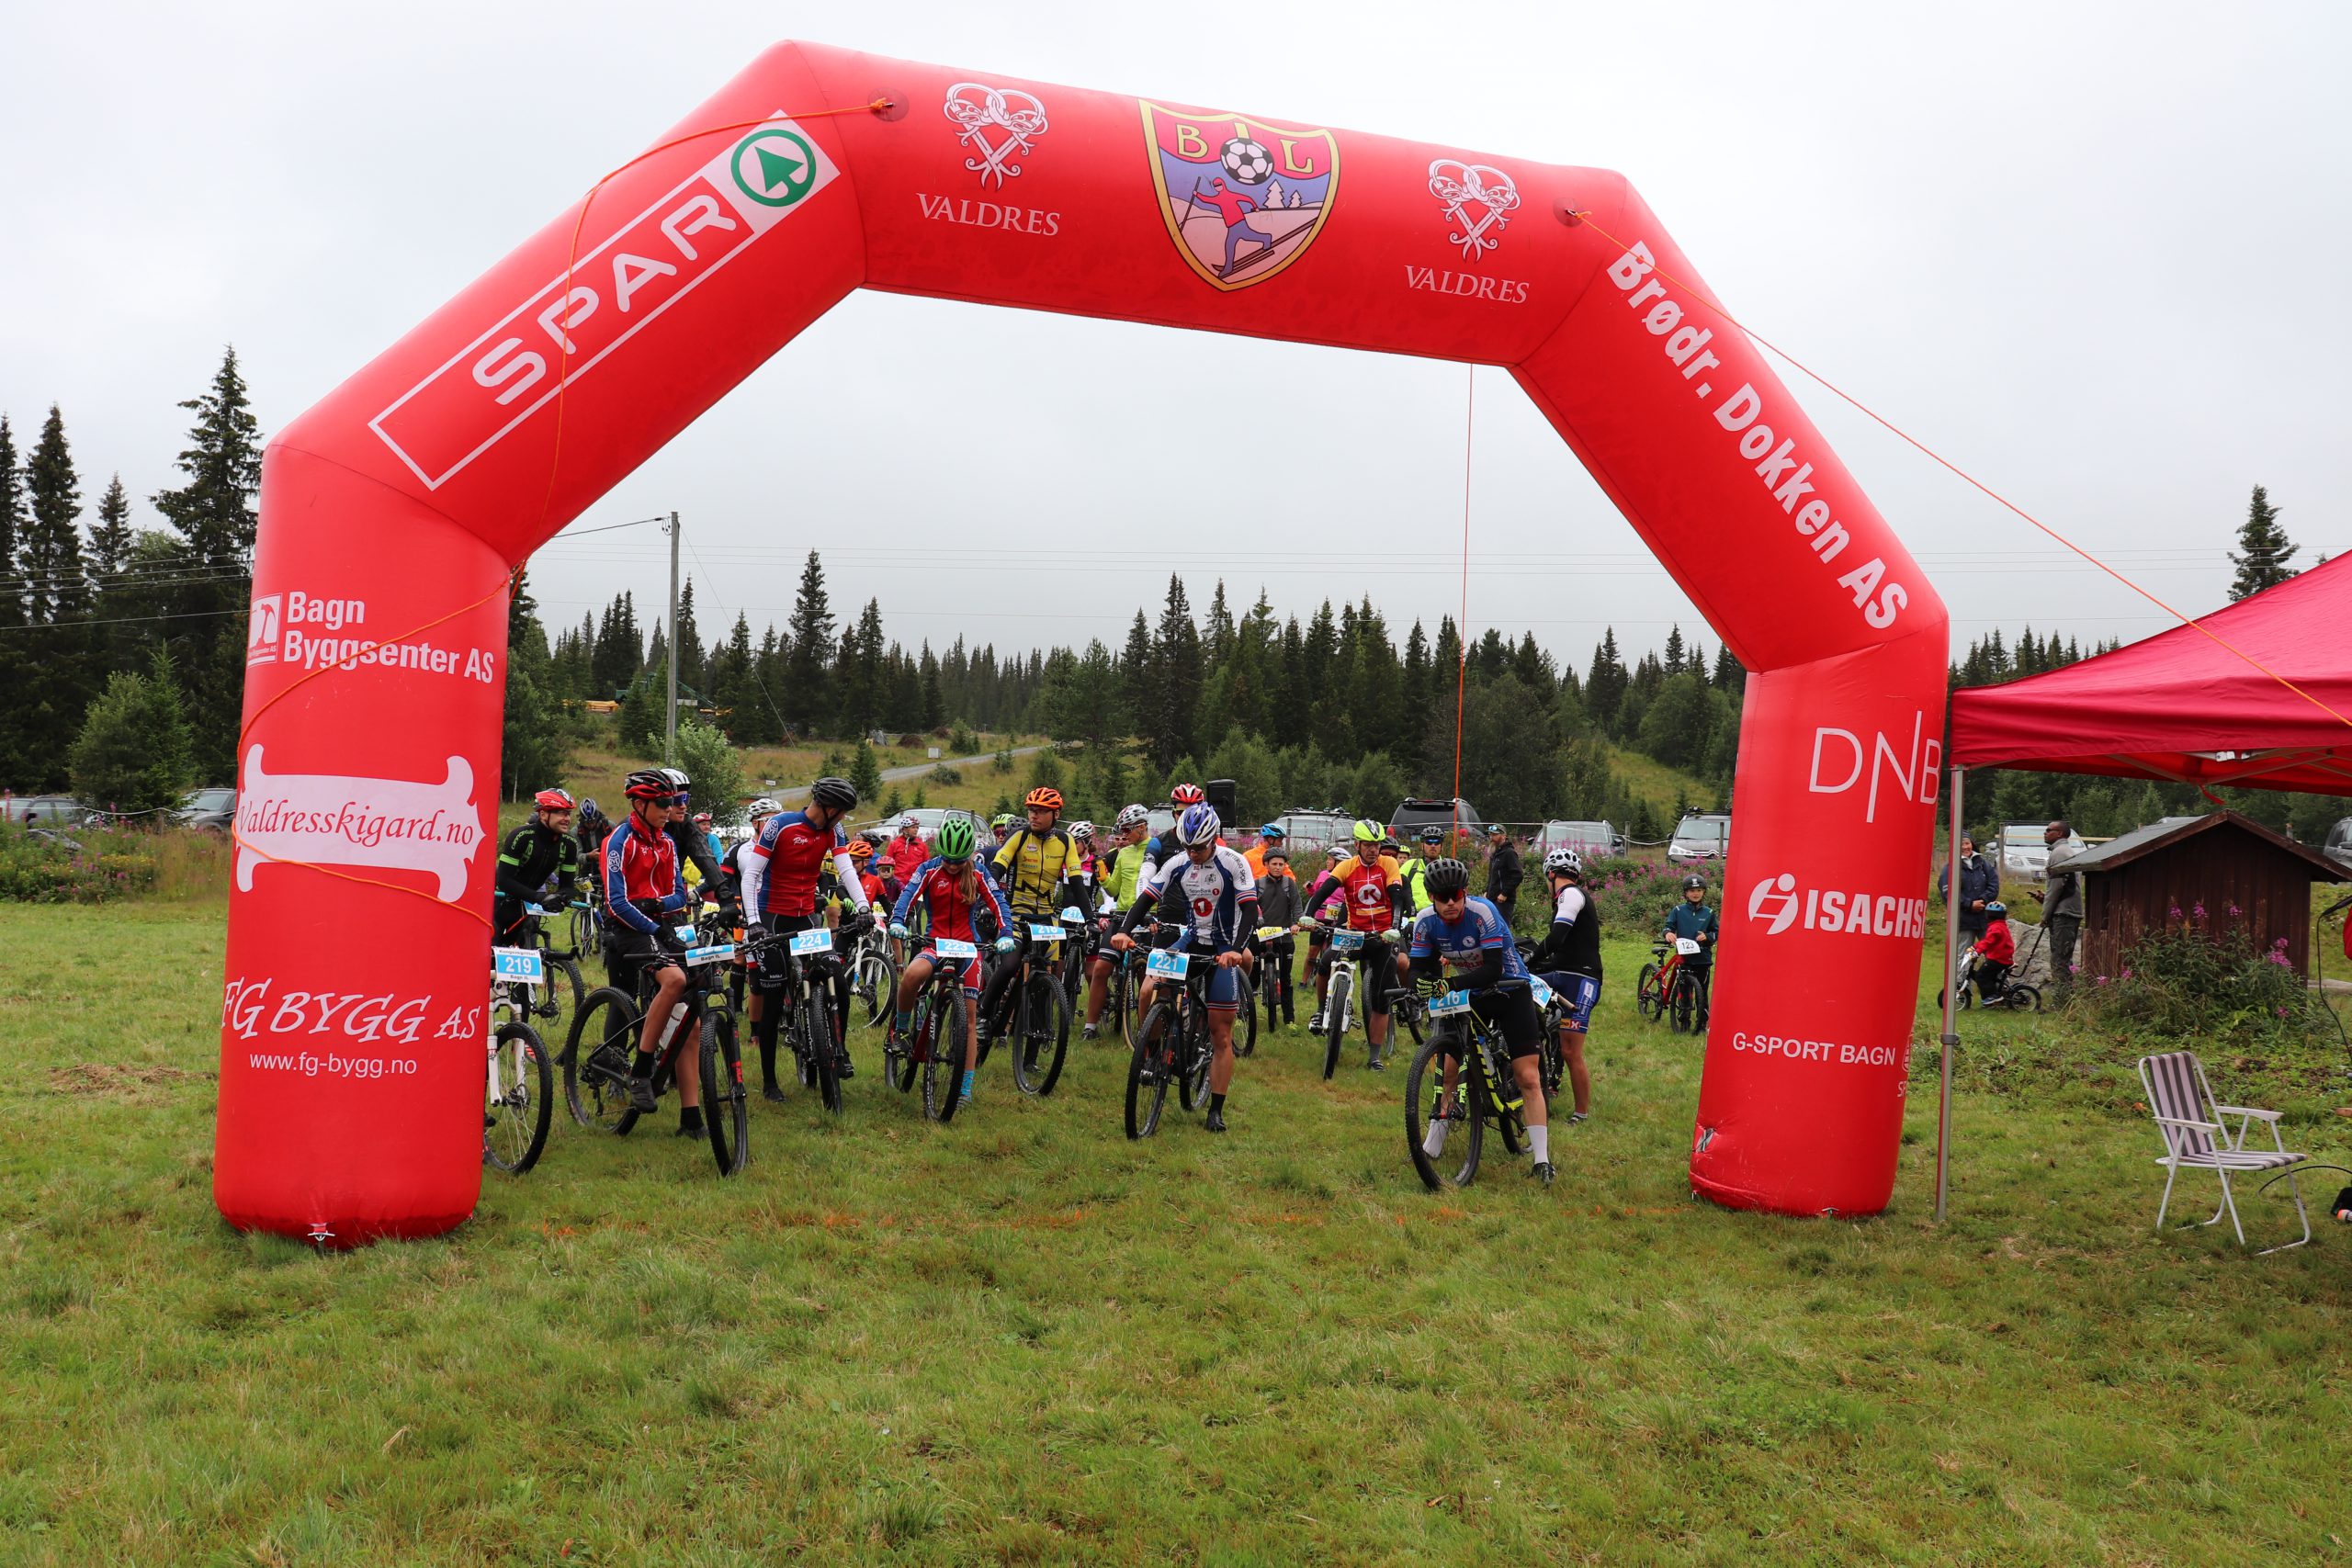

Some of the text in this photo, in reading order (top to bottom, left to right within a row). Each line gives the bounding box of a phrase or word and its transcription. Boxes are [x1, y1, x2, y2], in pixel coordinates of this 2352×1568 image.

[1176, 123, 1208, 159] B
[1279, 139, 1314, 174] L
[916, 192, 1061, 237] VALDRES
[472, 195, 737, 406] SPAR
[1404, 265, 1530, 304] VALDRES
[1606, 240, 1908, 629] Brødr. Dokken AS
[287, 591, 366, 630] Bagn
[283, 630, 495, 683] Byggsenter AS
[1808, 710, 1941, 824] DNB
[238, 799, 474, 848] Valdresskigard.no
[1804, 888, 1928, 939] ISACHS
[798, 934, 822, 947] 224
[944, 942, 968, 952] 223
[1681, 942, 1695, 950] 123
[505, 956, 532, 975] 219
[1155, 954, 1178, 970] 221
[221, 976, 481, 1044] FG BYGG AS
[1437, 991, 1461, 1007] 216
[249, 1052, 418, 1078] www.fg-bygg.no
[1732, 1032, 1896, 1066] G-SPORT BAGN
